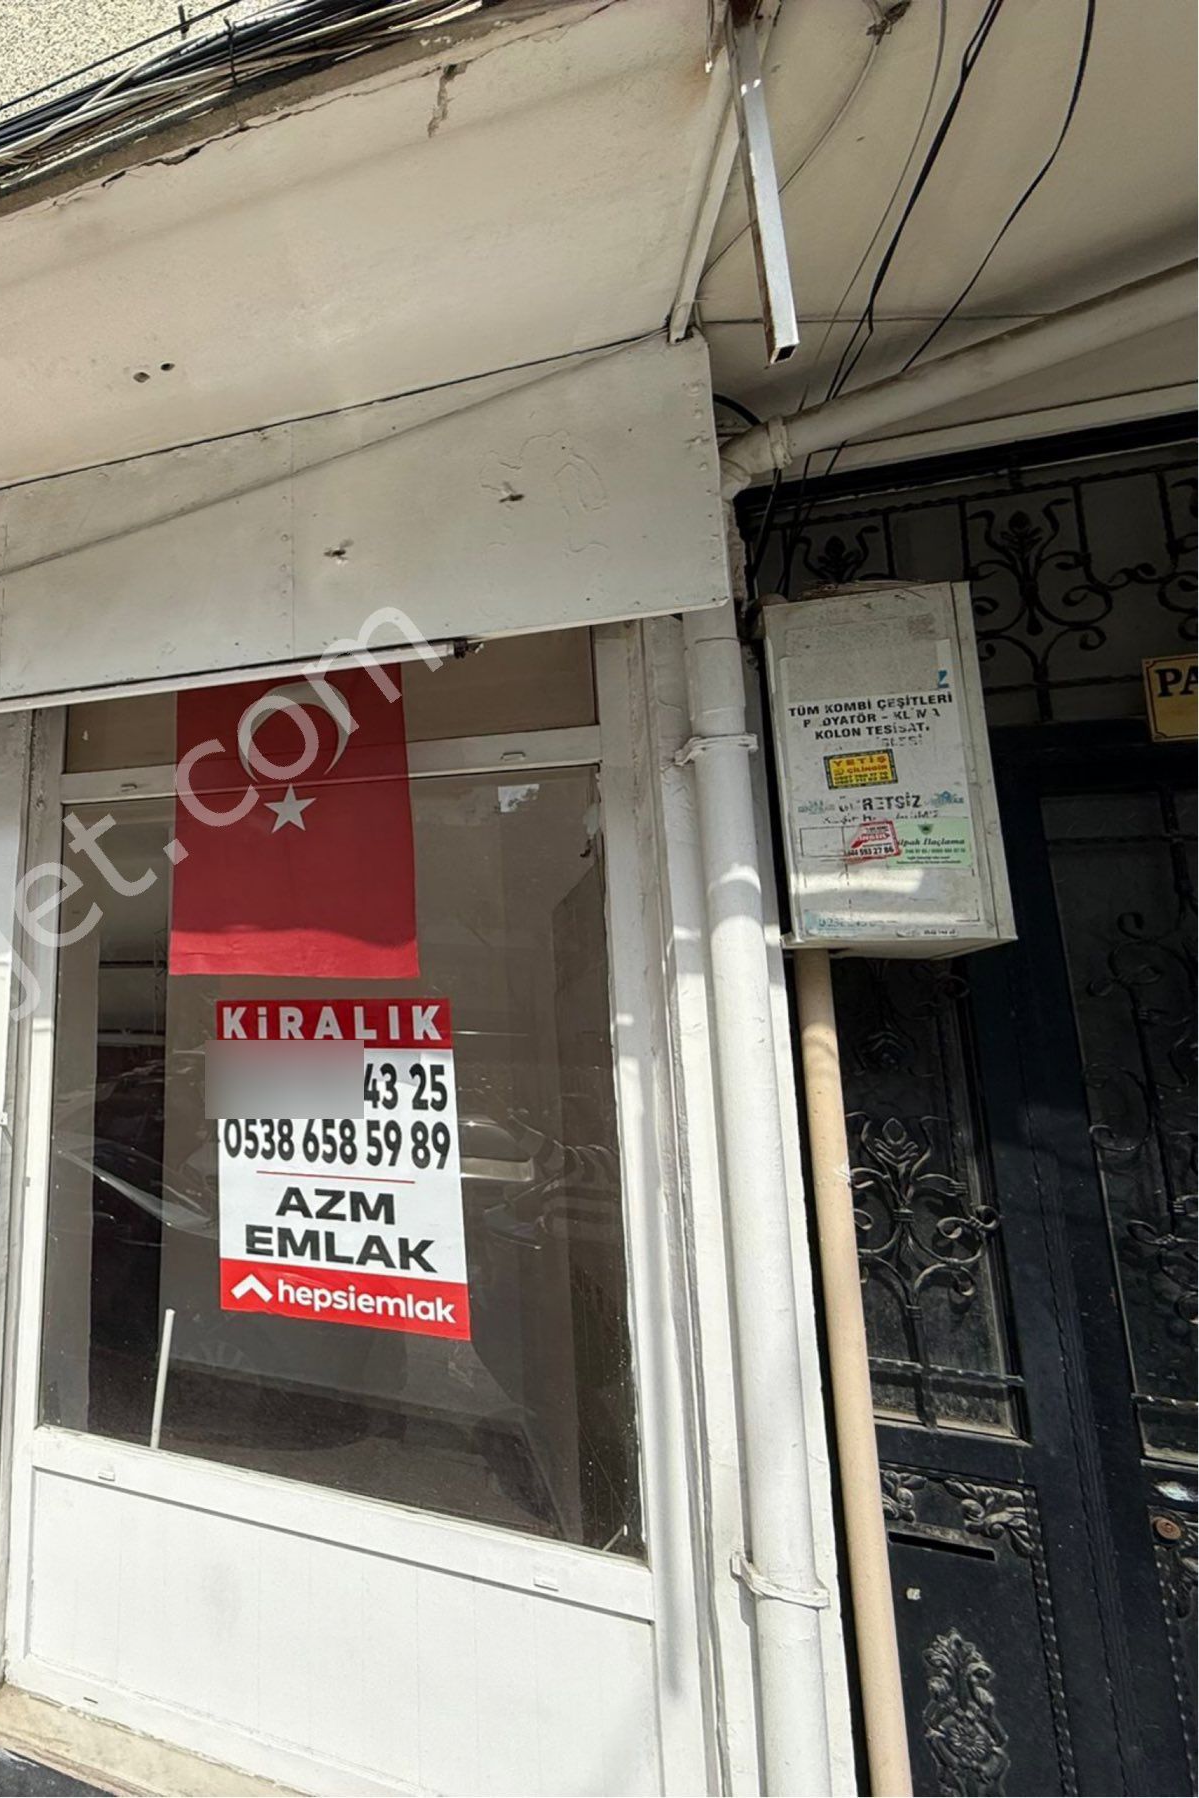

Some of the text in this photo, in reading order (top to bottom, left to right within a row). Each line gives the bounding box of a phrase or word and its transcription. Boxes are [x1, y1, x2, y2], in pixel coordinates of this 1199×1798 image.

[789, 692, 953, 717] TÜM KOMBİ ÇEŞİTLERİ
[815, 727, 861, 740] KOLON
[408, 1063, 449, 1112] 25
[223, 1118, 451, 1170] 0538 658 59 89
[275, 1186, 396, 1225] AZM
[245, 1224, 439, 1273] EMLAK
[277, 1278, 457, 1324] hepsiemlak
